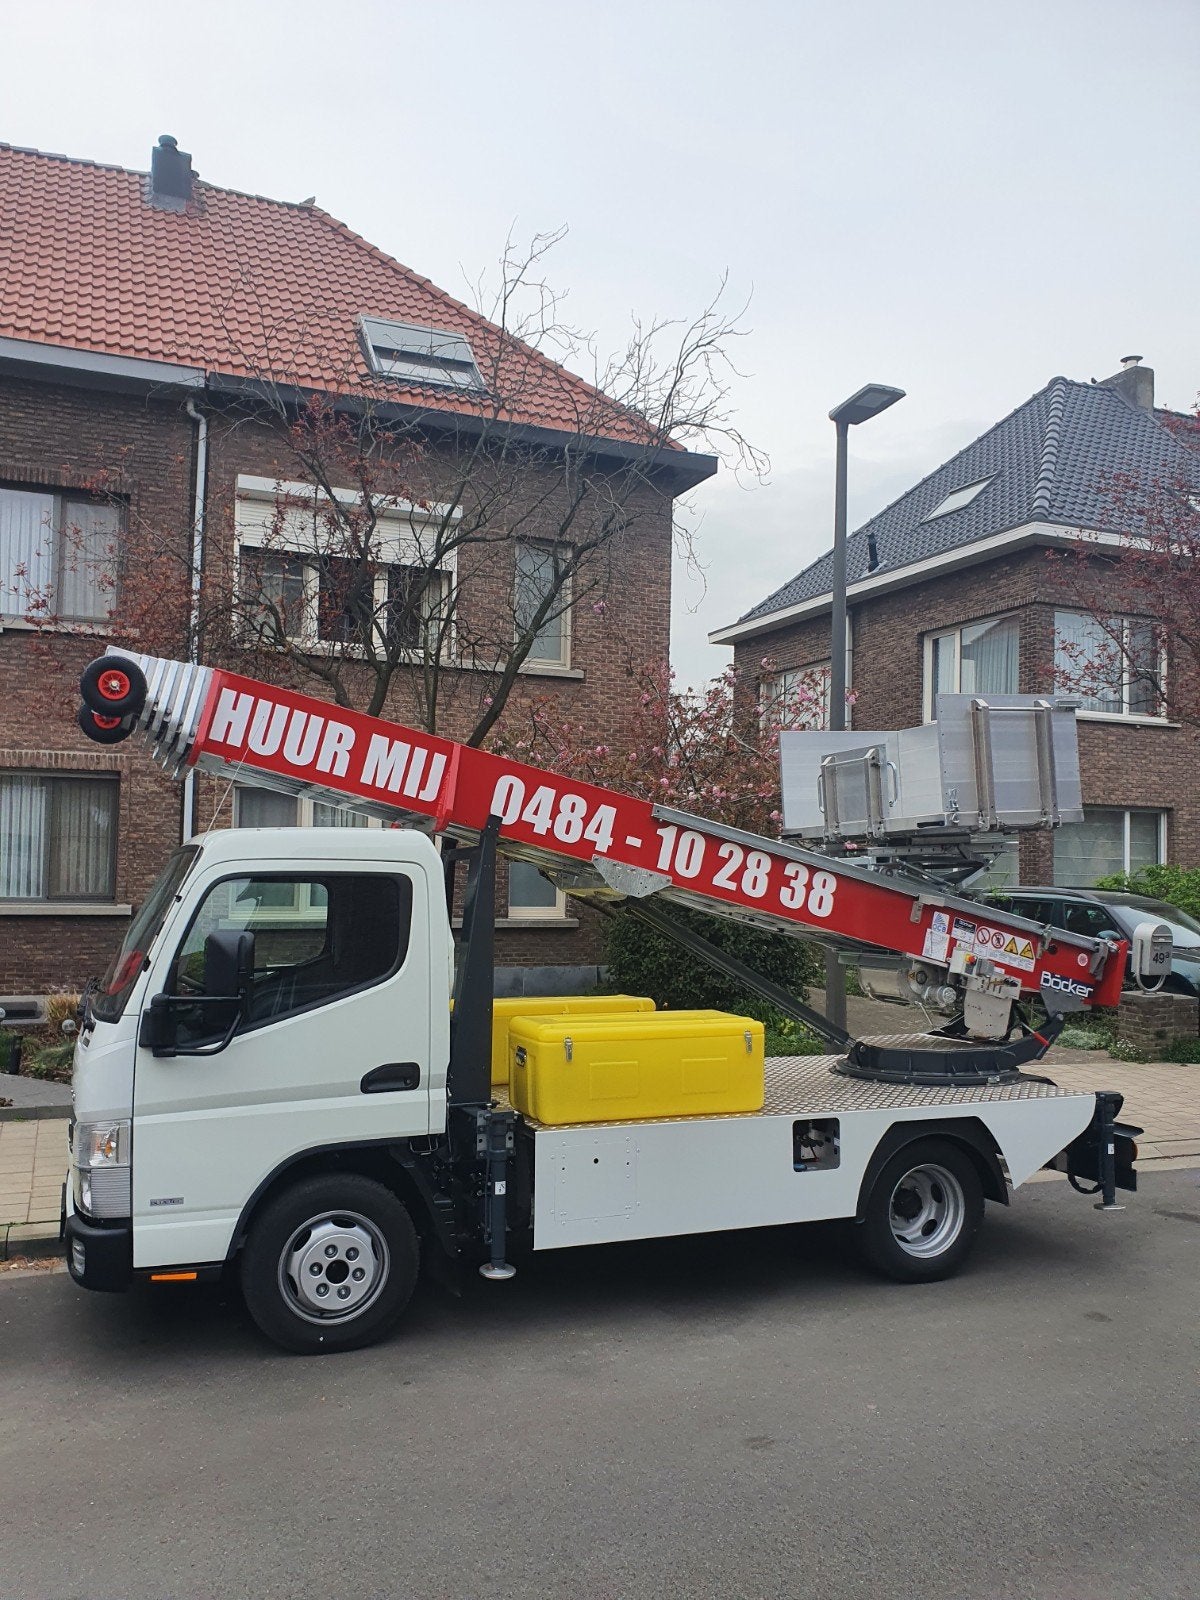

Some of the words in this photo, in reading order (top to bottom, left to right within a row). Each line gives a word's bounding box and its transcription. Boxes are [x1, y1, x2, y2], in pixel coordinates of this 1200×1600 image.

[208, 687, 356, 778] HUUR
[360, 733, 448, 802] MIJ
[490, 774, 617, 853] 0484
[625, 834, 643, 848] -
[656, 825, 706, 879] 10
[711, 842, 772, 899] 28
[779, 862, 837, 918] 38
[1040, 971, 1094, 998] Böcker
